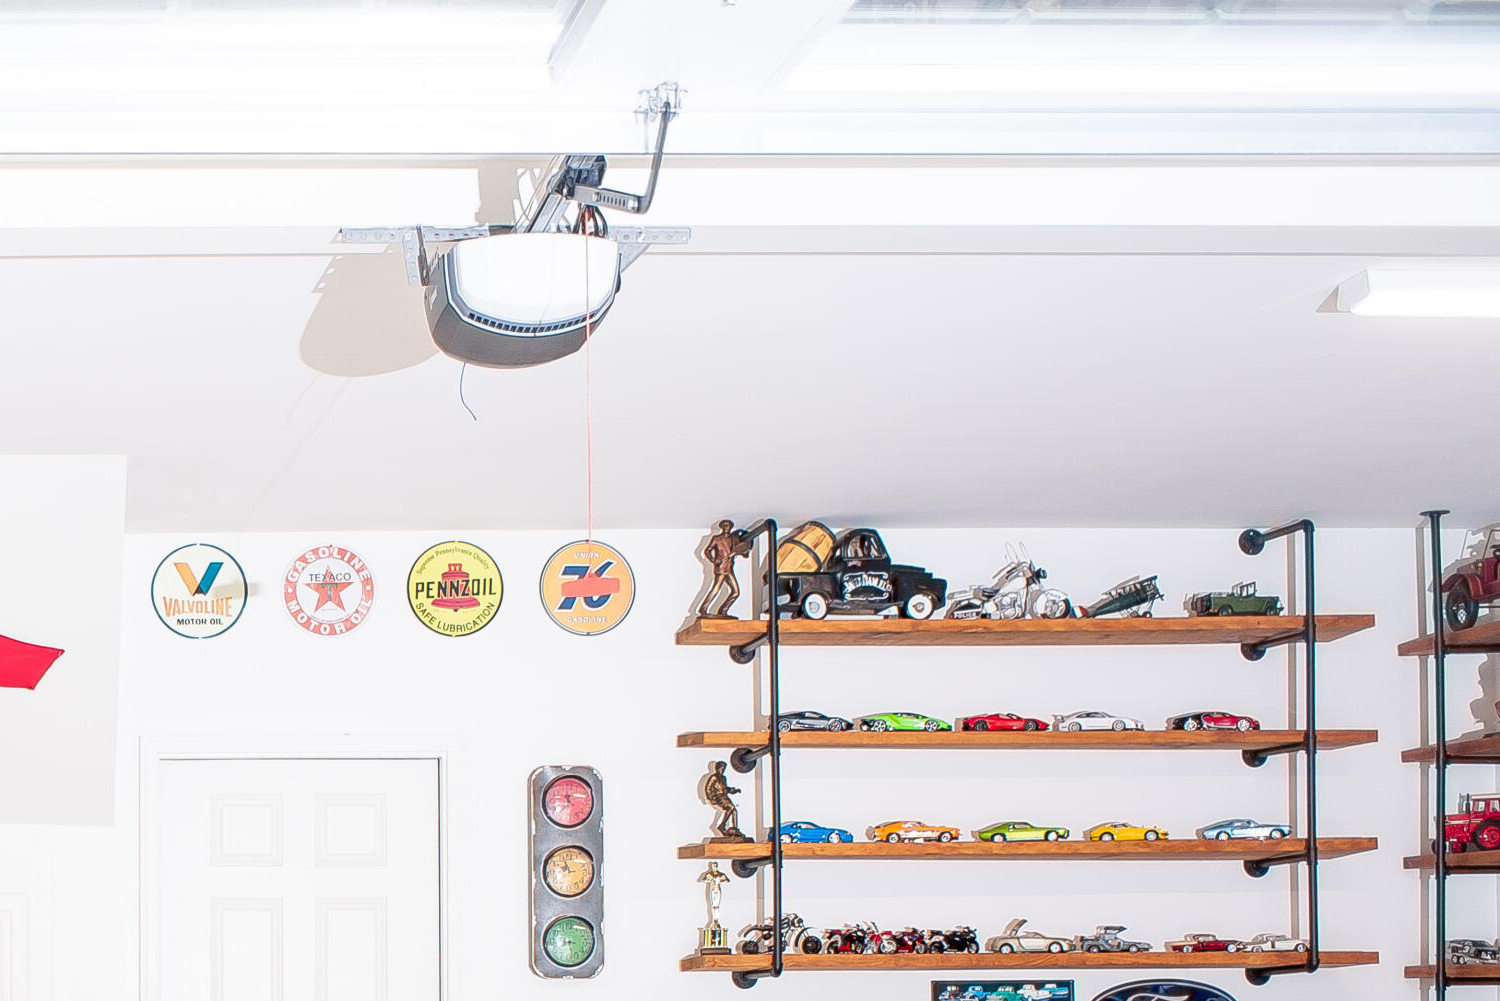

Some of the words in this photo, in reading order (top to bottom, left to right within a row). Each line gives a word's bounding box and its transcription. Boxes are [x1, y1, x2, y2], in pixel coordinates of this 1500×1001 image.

[287, 545, 371, 583] GASOLINE
[308, 572, 352, 582] TEXACO
[415, 577, 497, 600] PENNZOIL
[163, 596, 233, 617] VALVOLINE
[287, 599, 347, 635] MOTOR
[351, 596, 371, 624] OIL
[416, 602, 437, 625] SAFE
[437, 602, 496, 632] LUBRICATION
